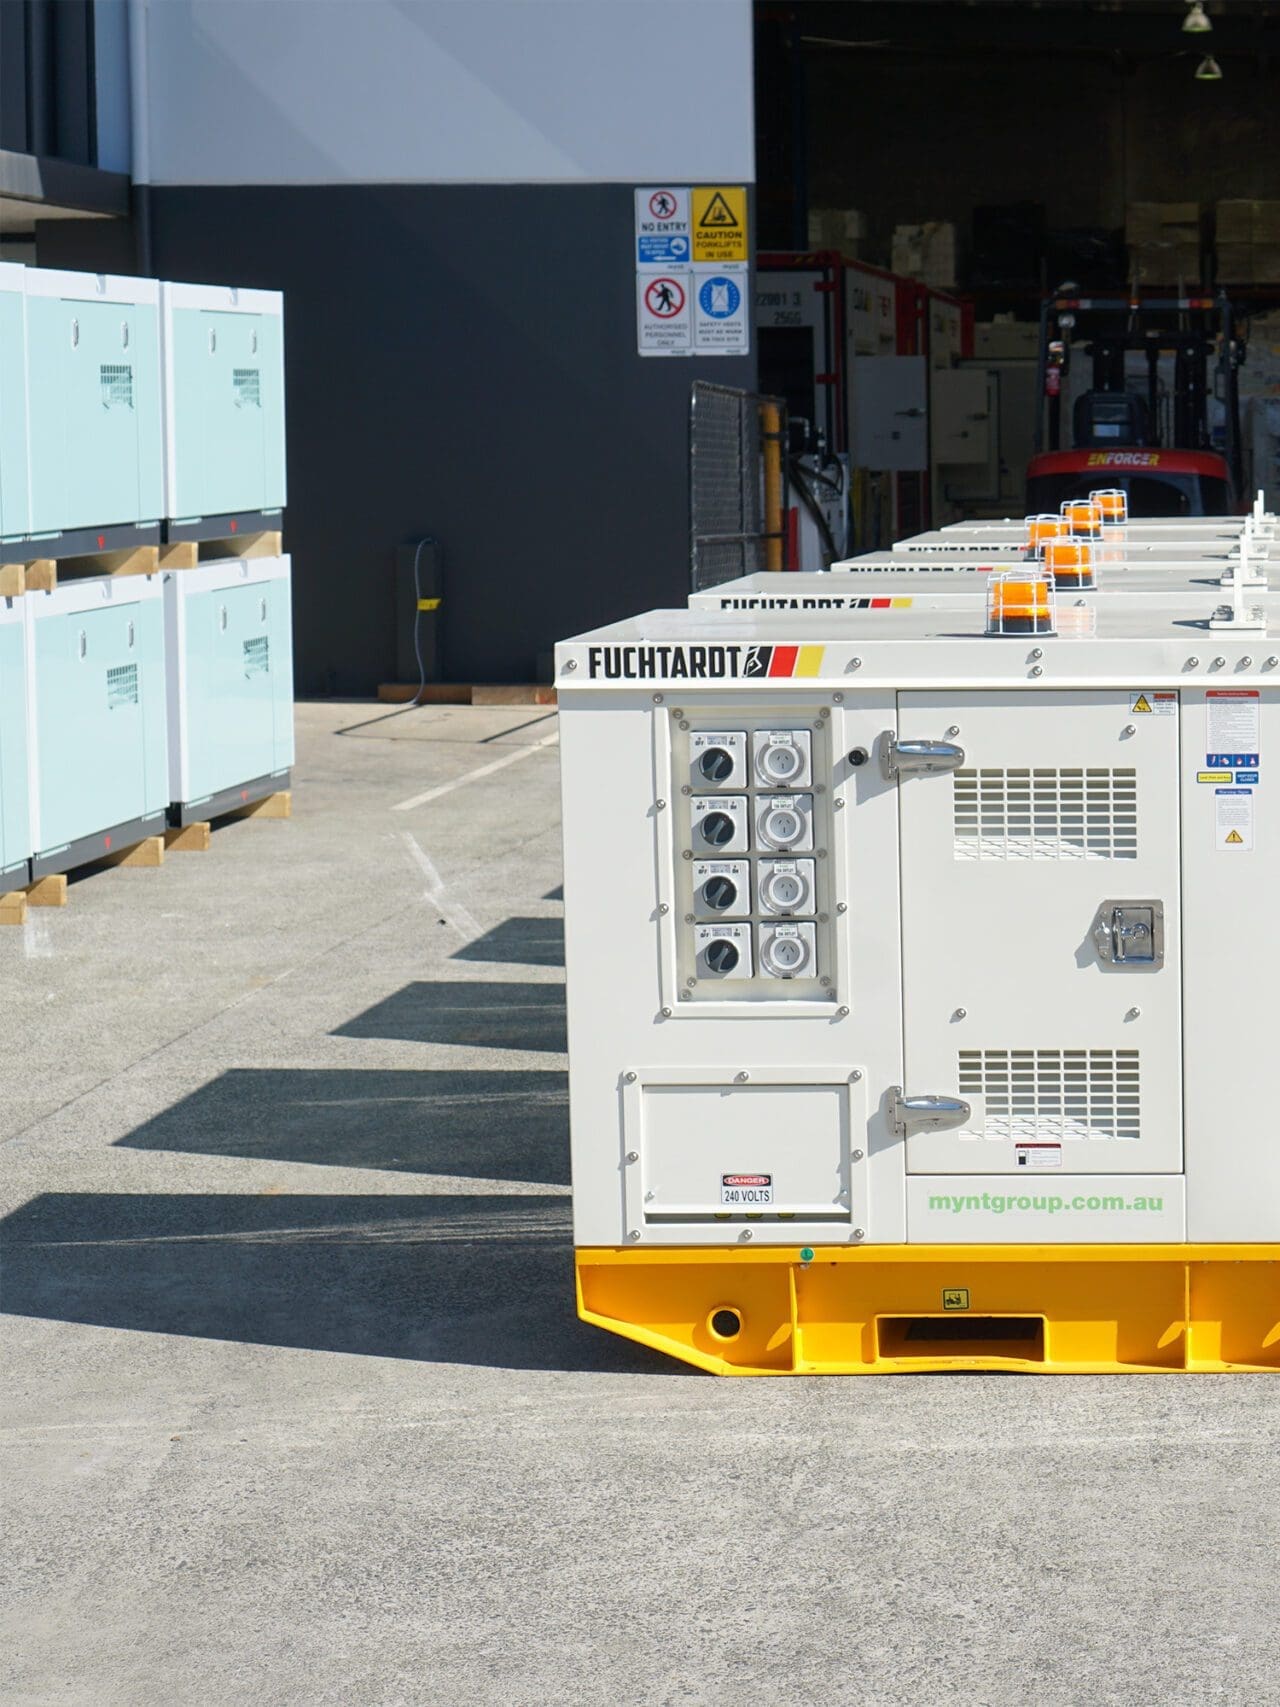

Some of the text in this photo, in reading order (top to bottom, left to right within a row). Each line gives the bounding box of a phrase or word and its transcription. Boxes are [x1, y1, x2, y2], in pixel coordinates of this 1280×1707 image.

[642, 222, 687, 232] NO ENTRY
[696, 231, 742, 239] CAUTION
[696, 241, 742, 249] FORKLIFTS
[1087, 452, 1160, 466] ENFORCER
[589, 645, 742, 679] FUCHTARDT
[725, 1190, 770, 1202] 240 VOLTS
[928, 1192, 1163, 1214] myntgroup.com.au
